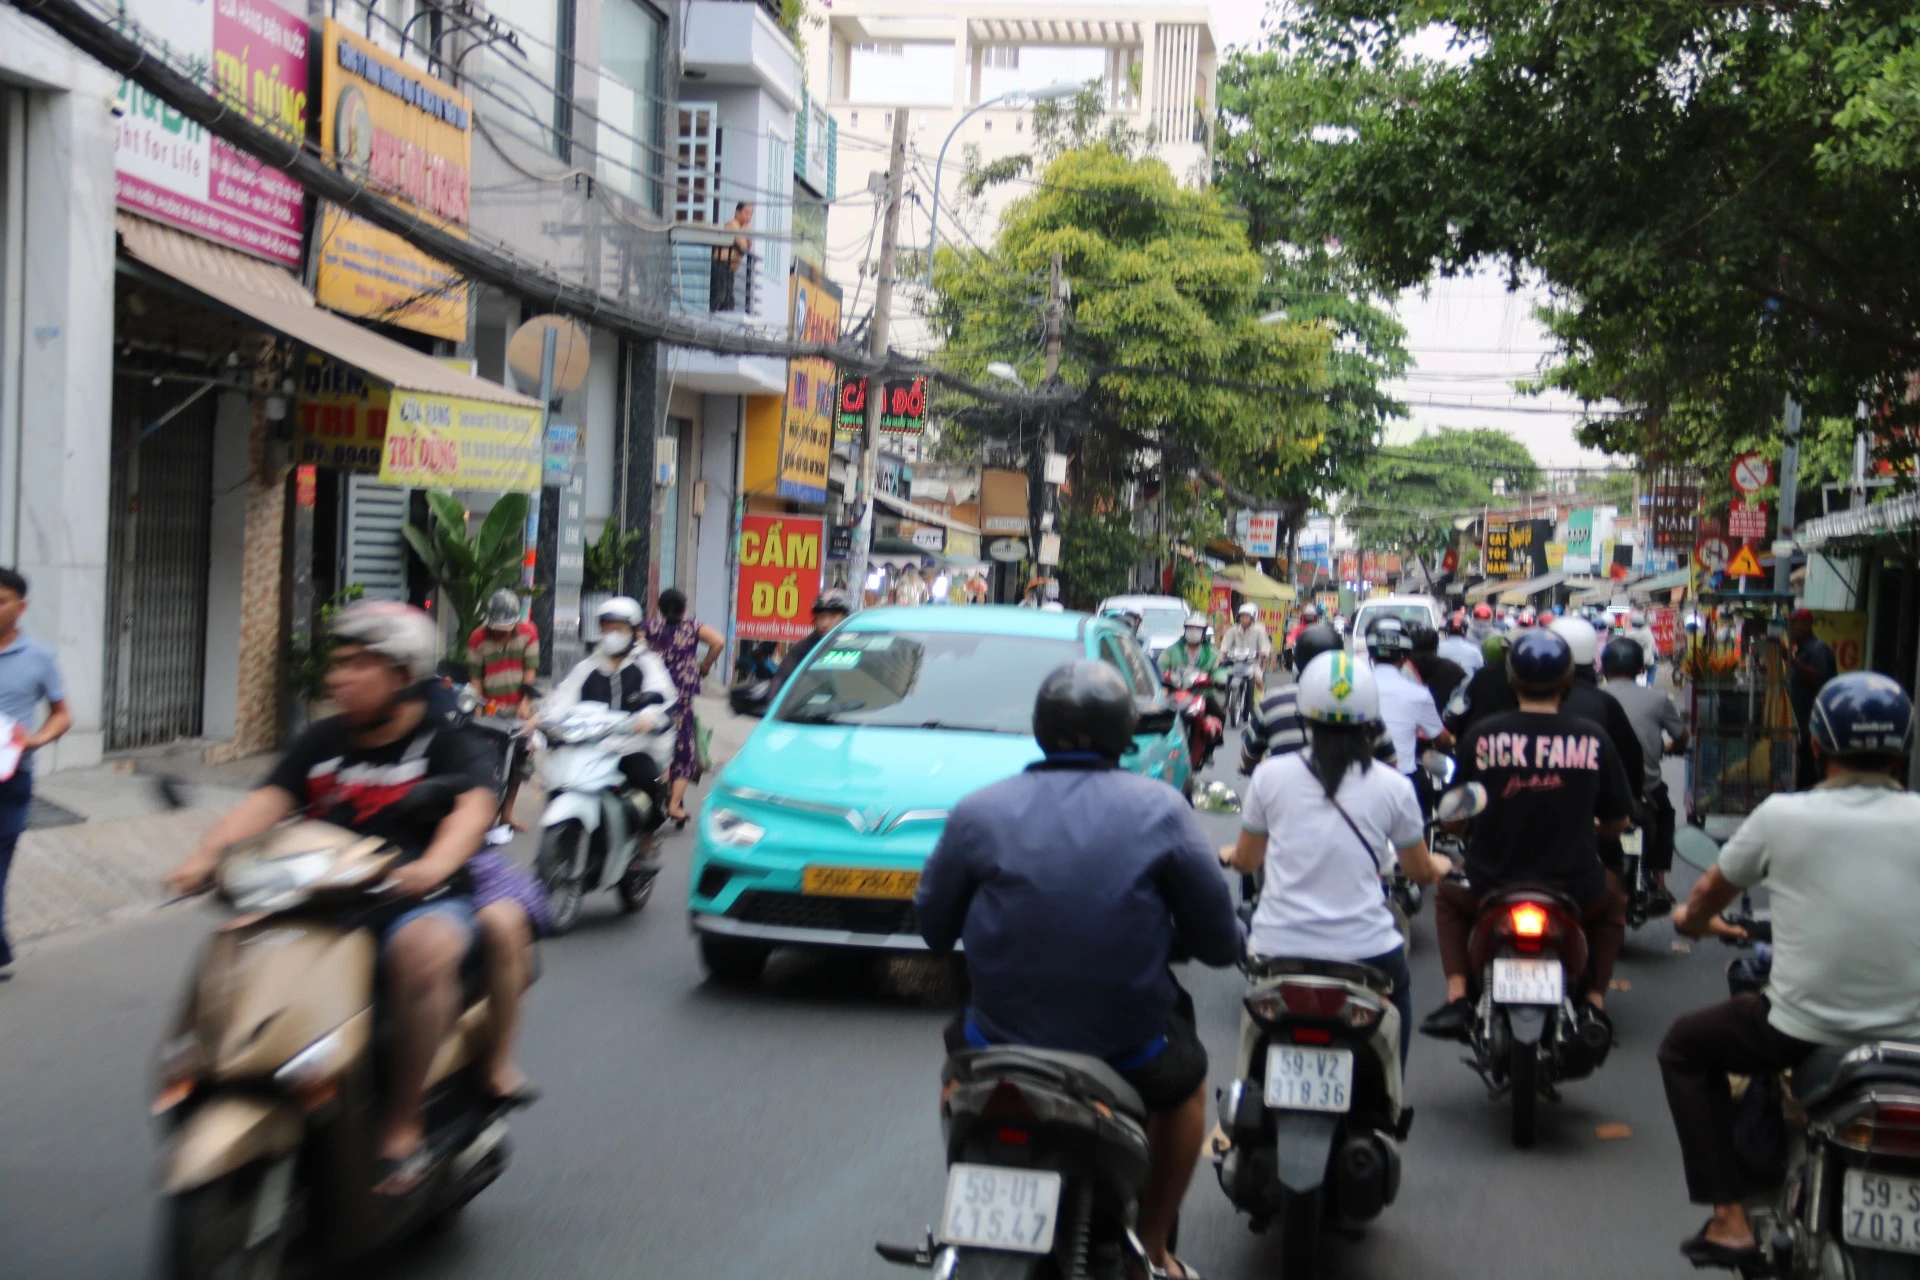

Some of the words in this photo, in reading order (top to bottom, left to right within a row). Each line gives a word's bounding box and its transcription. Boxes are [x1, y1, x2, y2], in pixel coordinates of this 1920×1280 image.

[172, 143, 201, 178] Life
[1475, 731, 1529, 771] SICK
[1535, 734, 1600, 771] FAME
